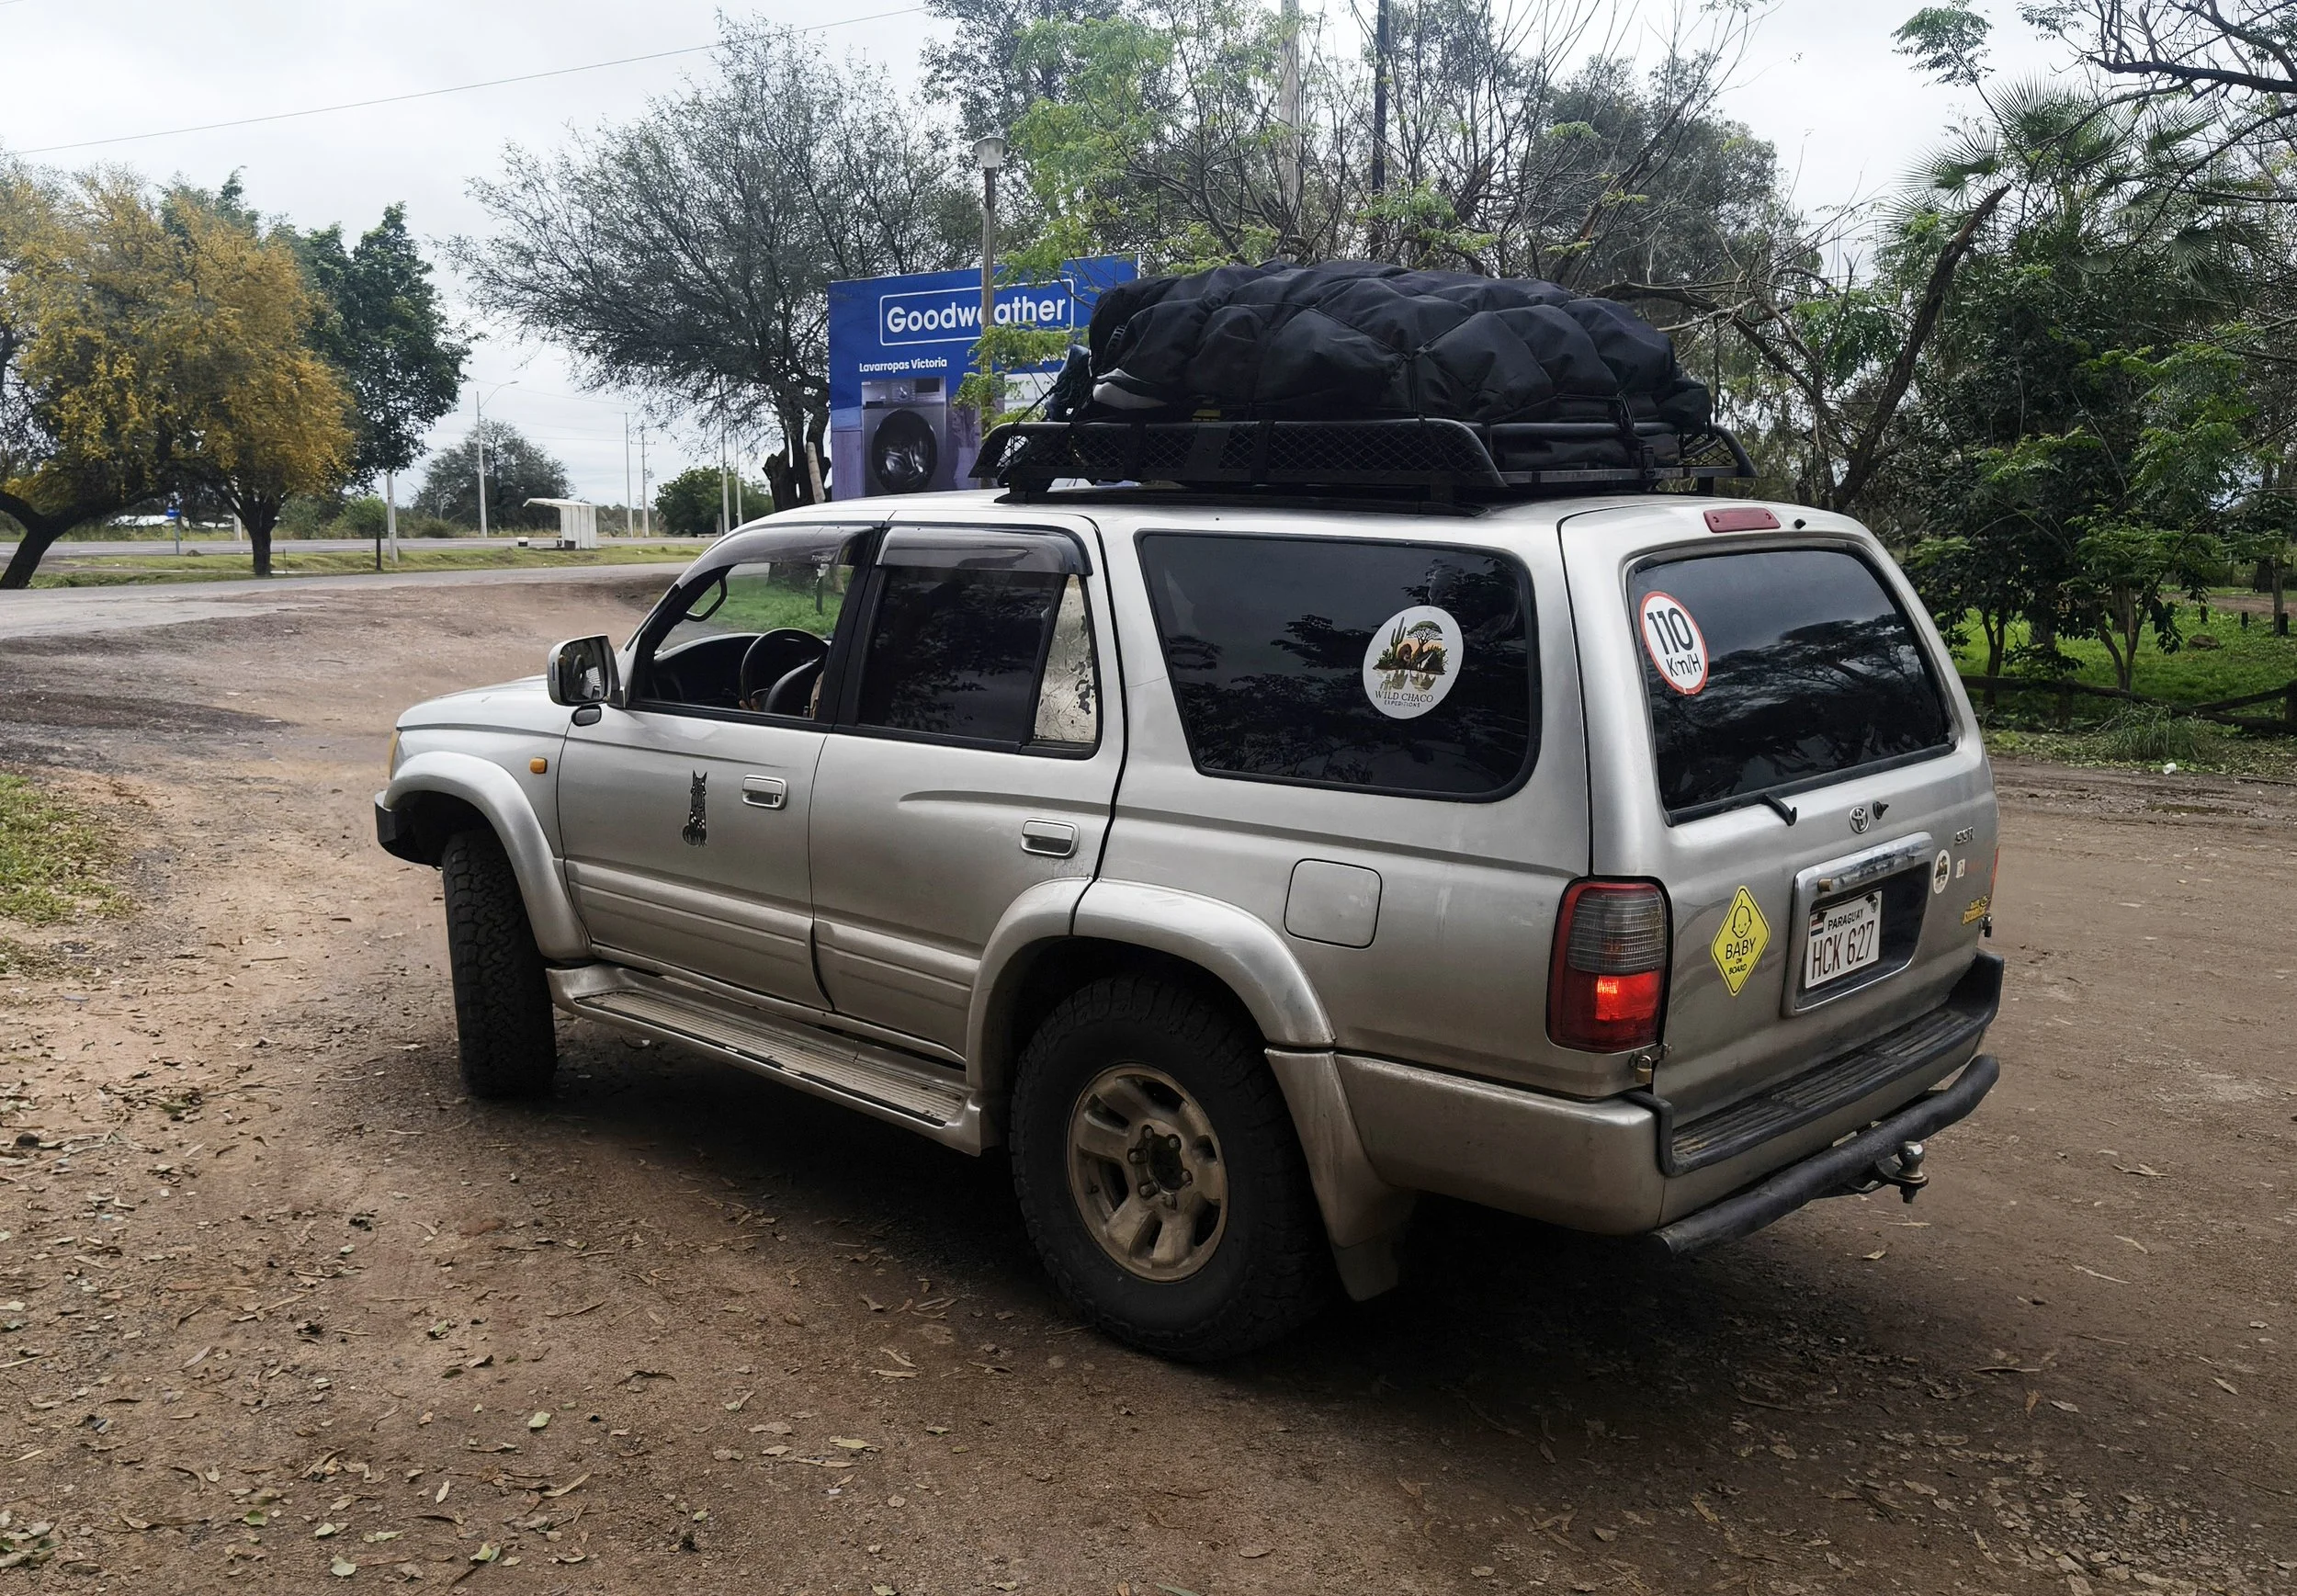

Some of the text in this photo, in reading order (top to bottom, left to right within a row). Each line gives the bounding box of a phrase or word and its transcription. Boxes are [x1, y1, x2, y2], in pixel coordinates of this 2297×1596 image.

[887, 296, 1066, 334] Goodwather
[859, 357, 947, 373] Lavarropas Victoria
[1646, 607, 1693, 655] 110
[1375, 690, 1433, 703] WILD CHACO
[1827, 908, 1863, 931] PARAGUAY
[1726, 936, 1756, 959] BABY
[1812, 920, 1875, 980] HCK 627
[1728, 963, 1748, 975] BOARD
